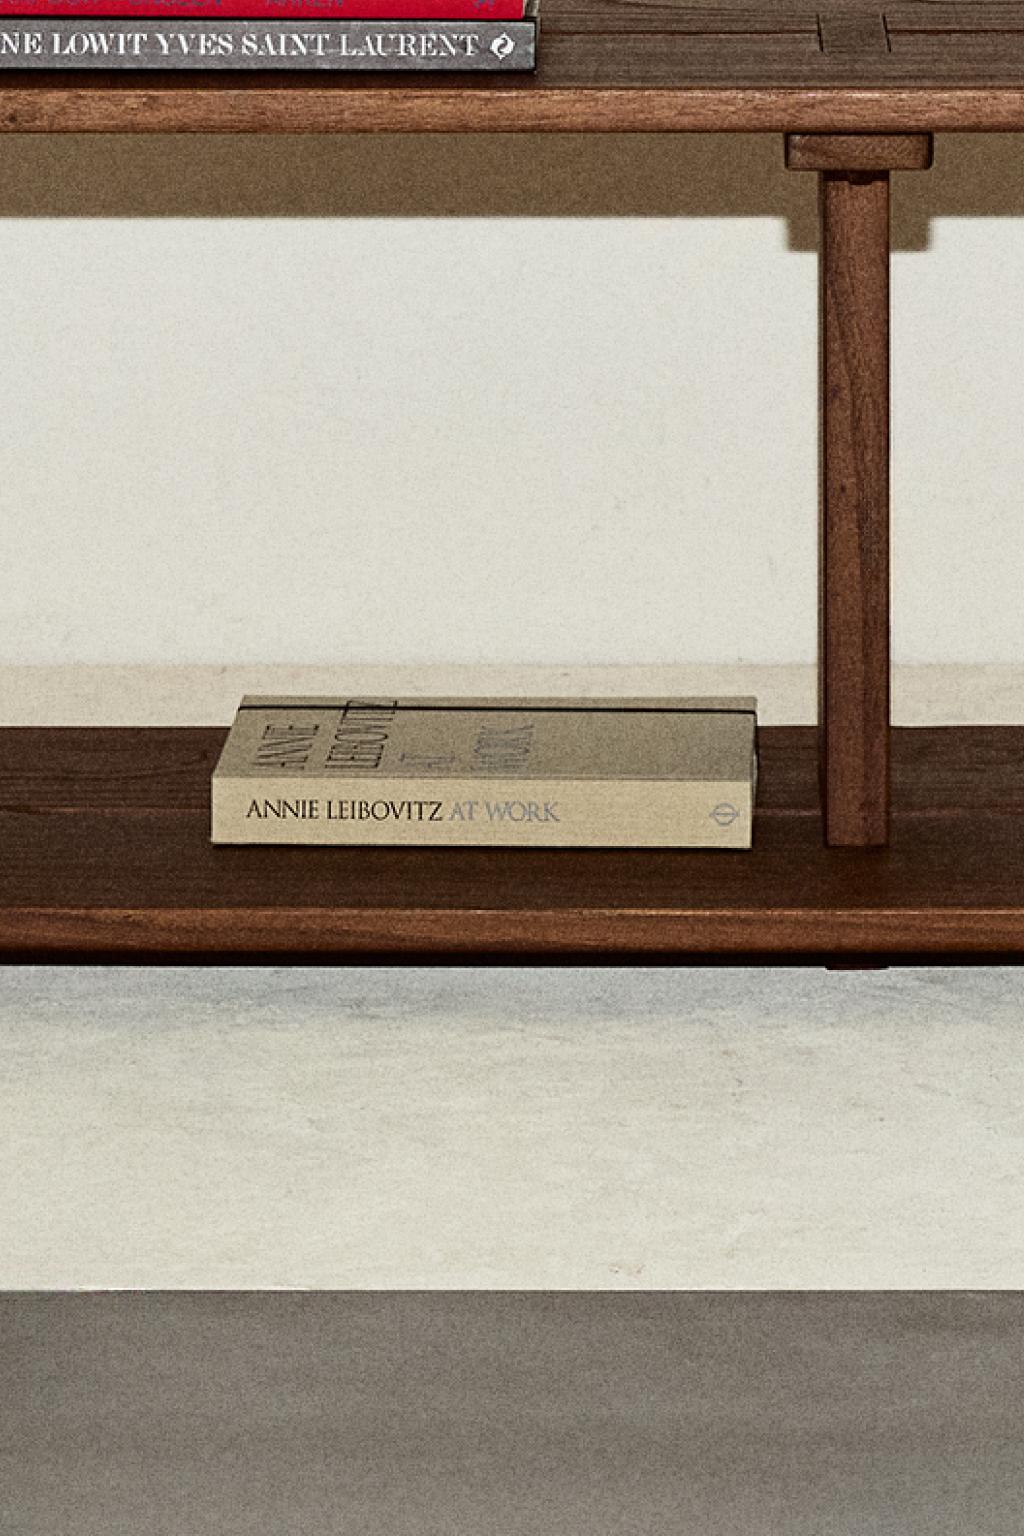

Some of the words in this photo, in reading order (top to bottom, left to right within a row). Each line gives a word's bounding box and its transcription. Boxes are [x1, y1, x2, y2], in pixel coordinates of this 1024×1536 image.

[51, 31, 148, 56] LOWIT
[154, 32, 234, 56] YVES
[240, 32, 331, 57] SAINT
[338, 32, 479, 57] LAURENT
[245, 798, 319, 820] ANNIE
[326, 799, 444, 822] LEIBOVITZ
[448, 800, 478, 822] AT
[484, 801, 561, 823] WORK
